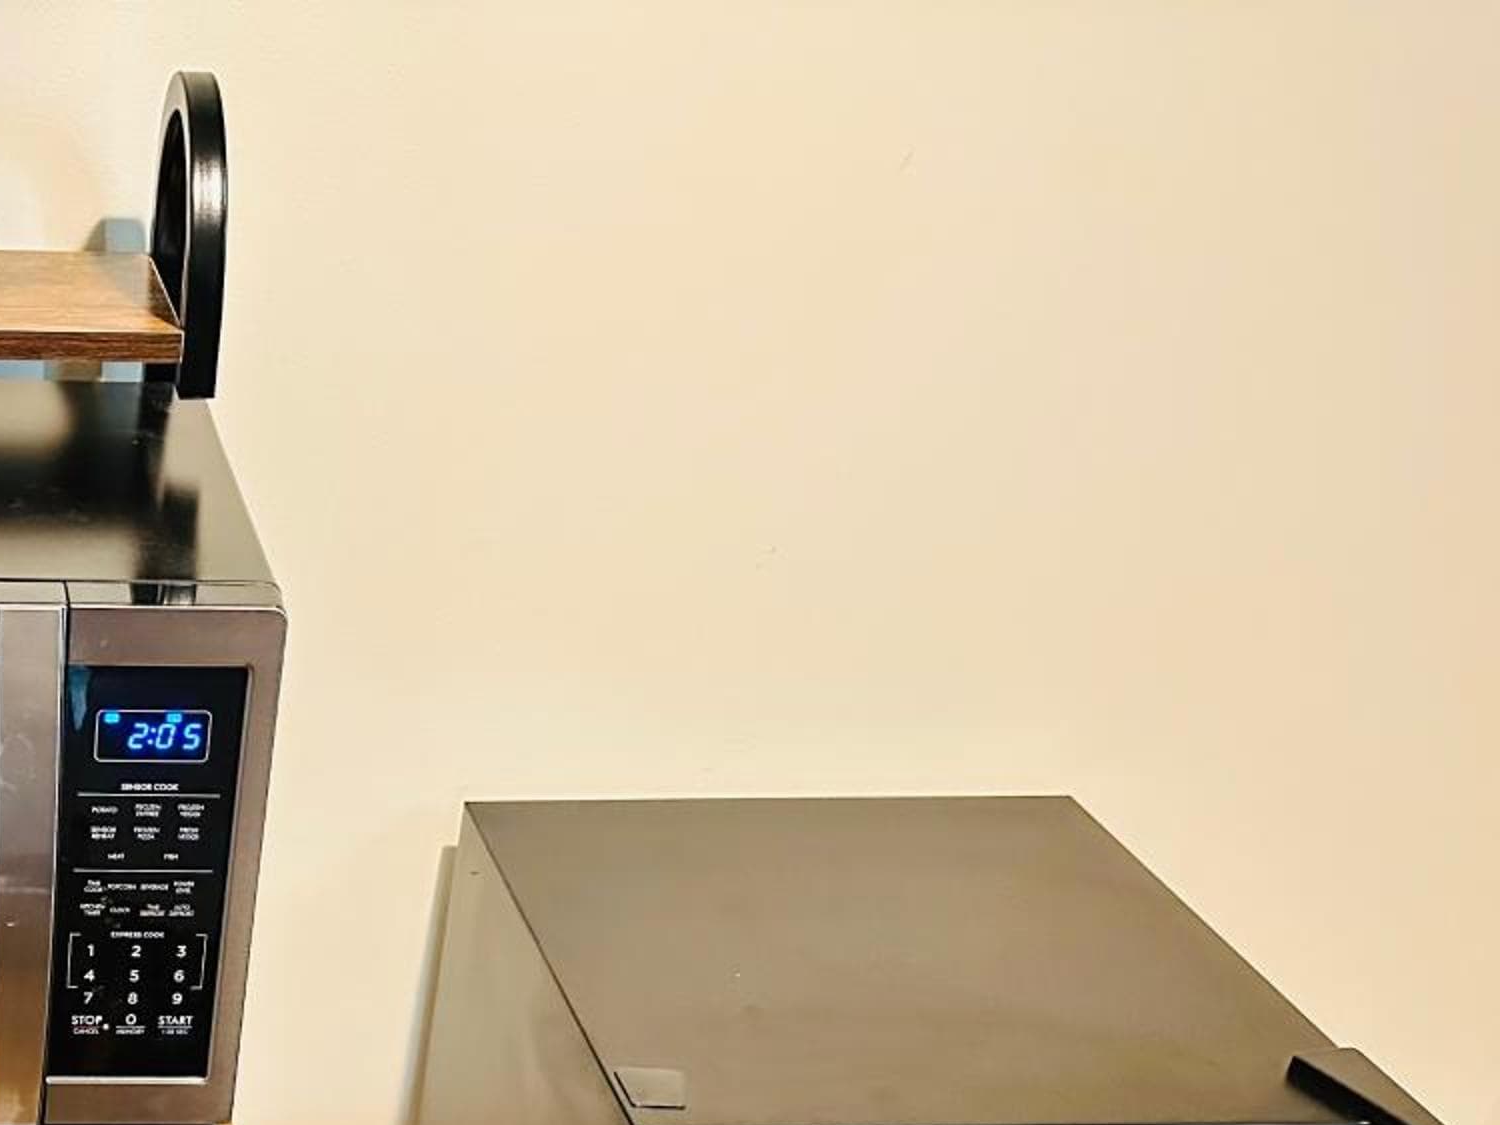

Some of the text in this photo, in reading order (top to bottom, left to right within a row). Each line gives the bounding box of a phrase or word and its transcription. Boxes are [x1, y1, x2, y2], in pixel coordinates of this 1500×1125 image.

[127, 723, 202, 750] 2:05
[121, 783, 179, 791] SENSOR COOK
[143, 931, 165, 939] COOK
[87, 944, 95, 957] 1
[131, 945, 142, 958] 2
[176, 945, 187, 958] 3
[83, 969, 95, 982] 4
[129, 969, 140, 982] 5
[173, 970, 185, 982] 6
[84, 992, 93, 1004] 7
[127, 992, 138, 1005] 8
[171, 992, 183, 1005] 9
[71, 1015, 103, 1025] STOP
[158, 1015, 193, 1025] START
